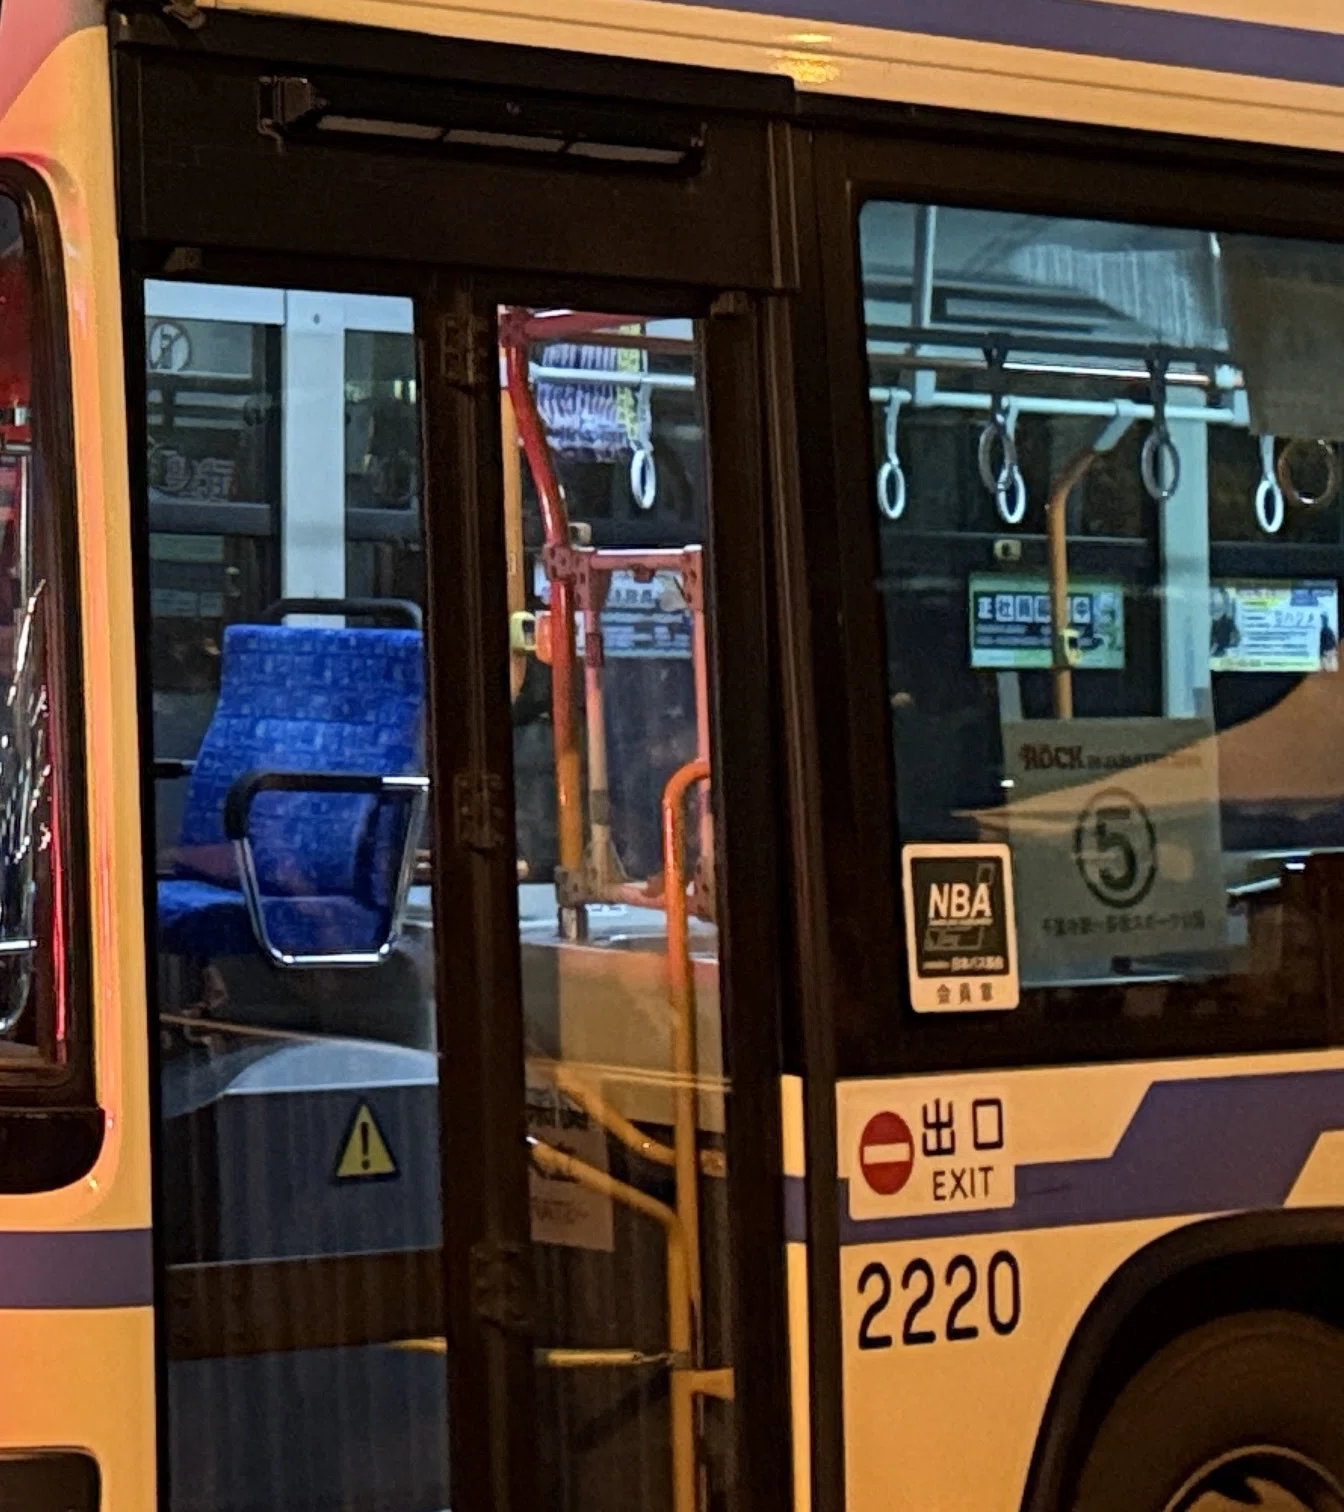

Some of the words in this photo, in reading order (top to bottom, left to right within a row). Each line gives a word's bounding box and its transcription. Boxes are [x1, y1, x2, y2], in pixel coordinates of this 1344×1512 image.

[928, 882, 993, 919] NBA
[922, 1097, 1005, 1158] 出口
[932, 1165, 994, 1202] EXIT
[856, 1249, 1021, 1351] 2220
